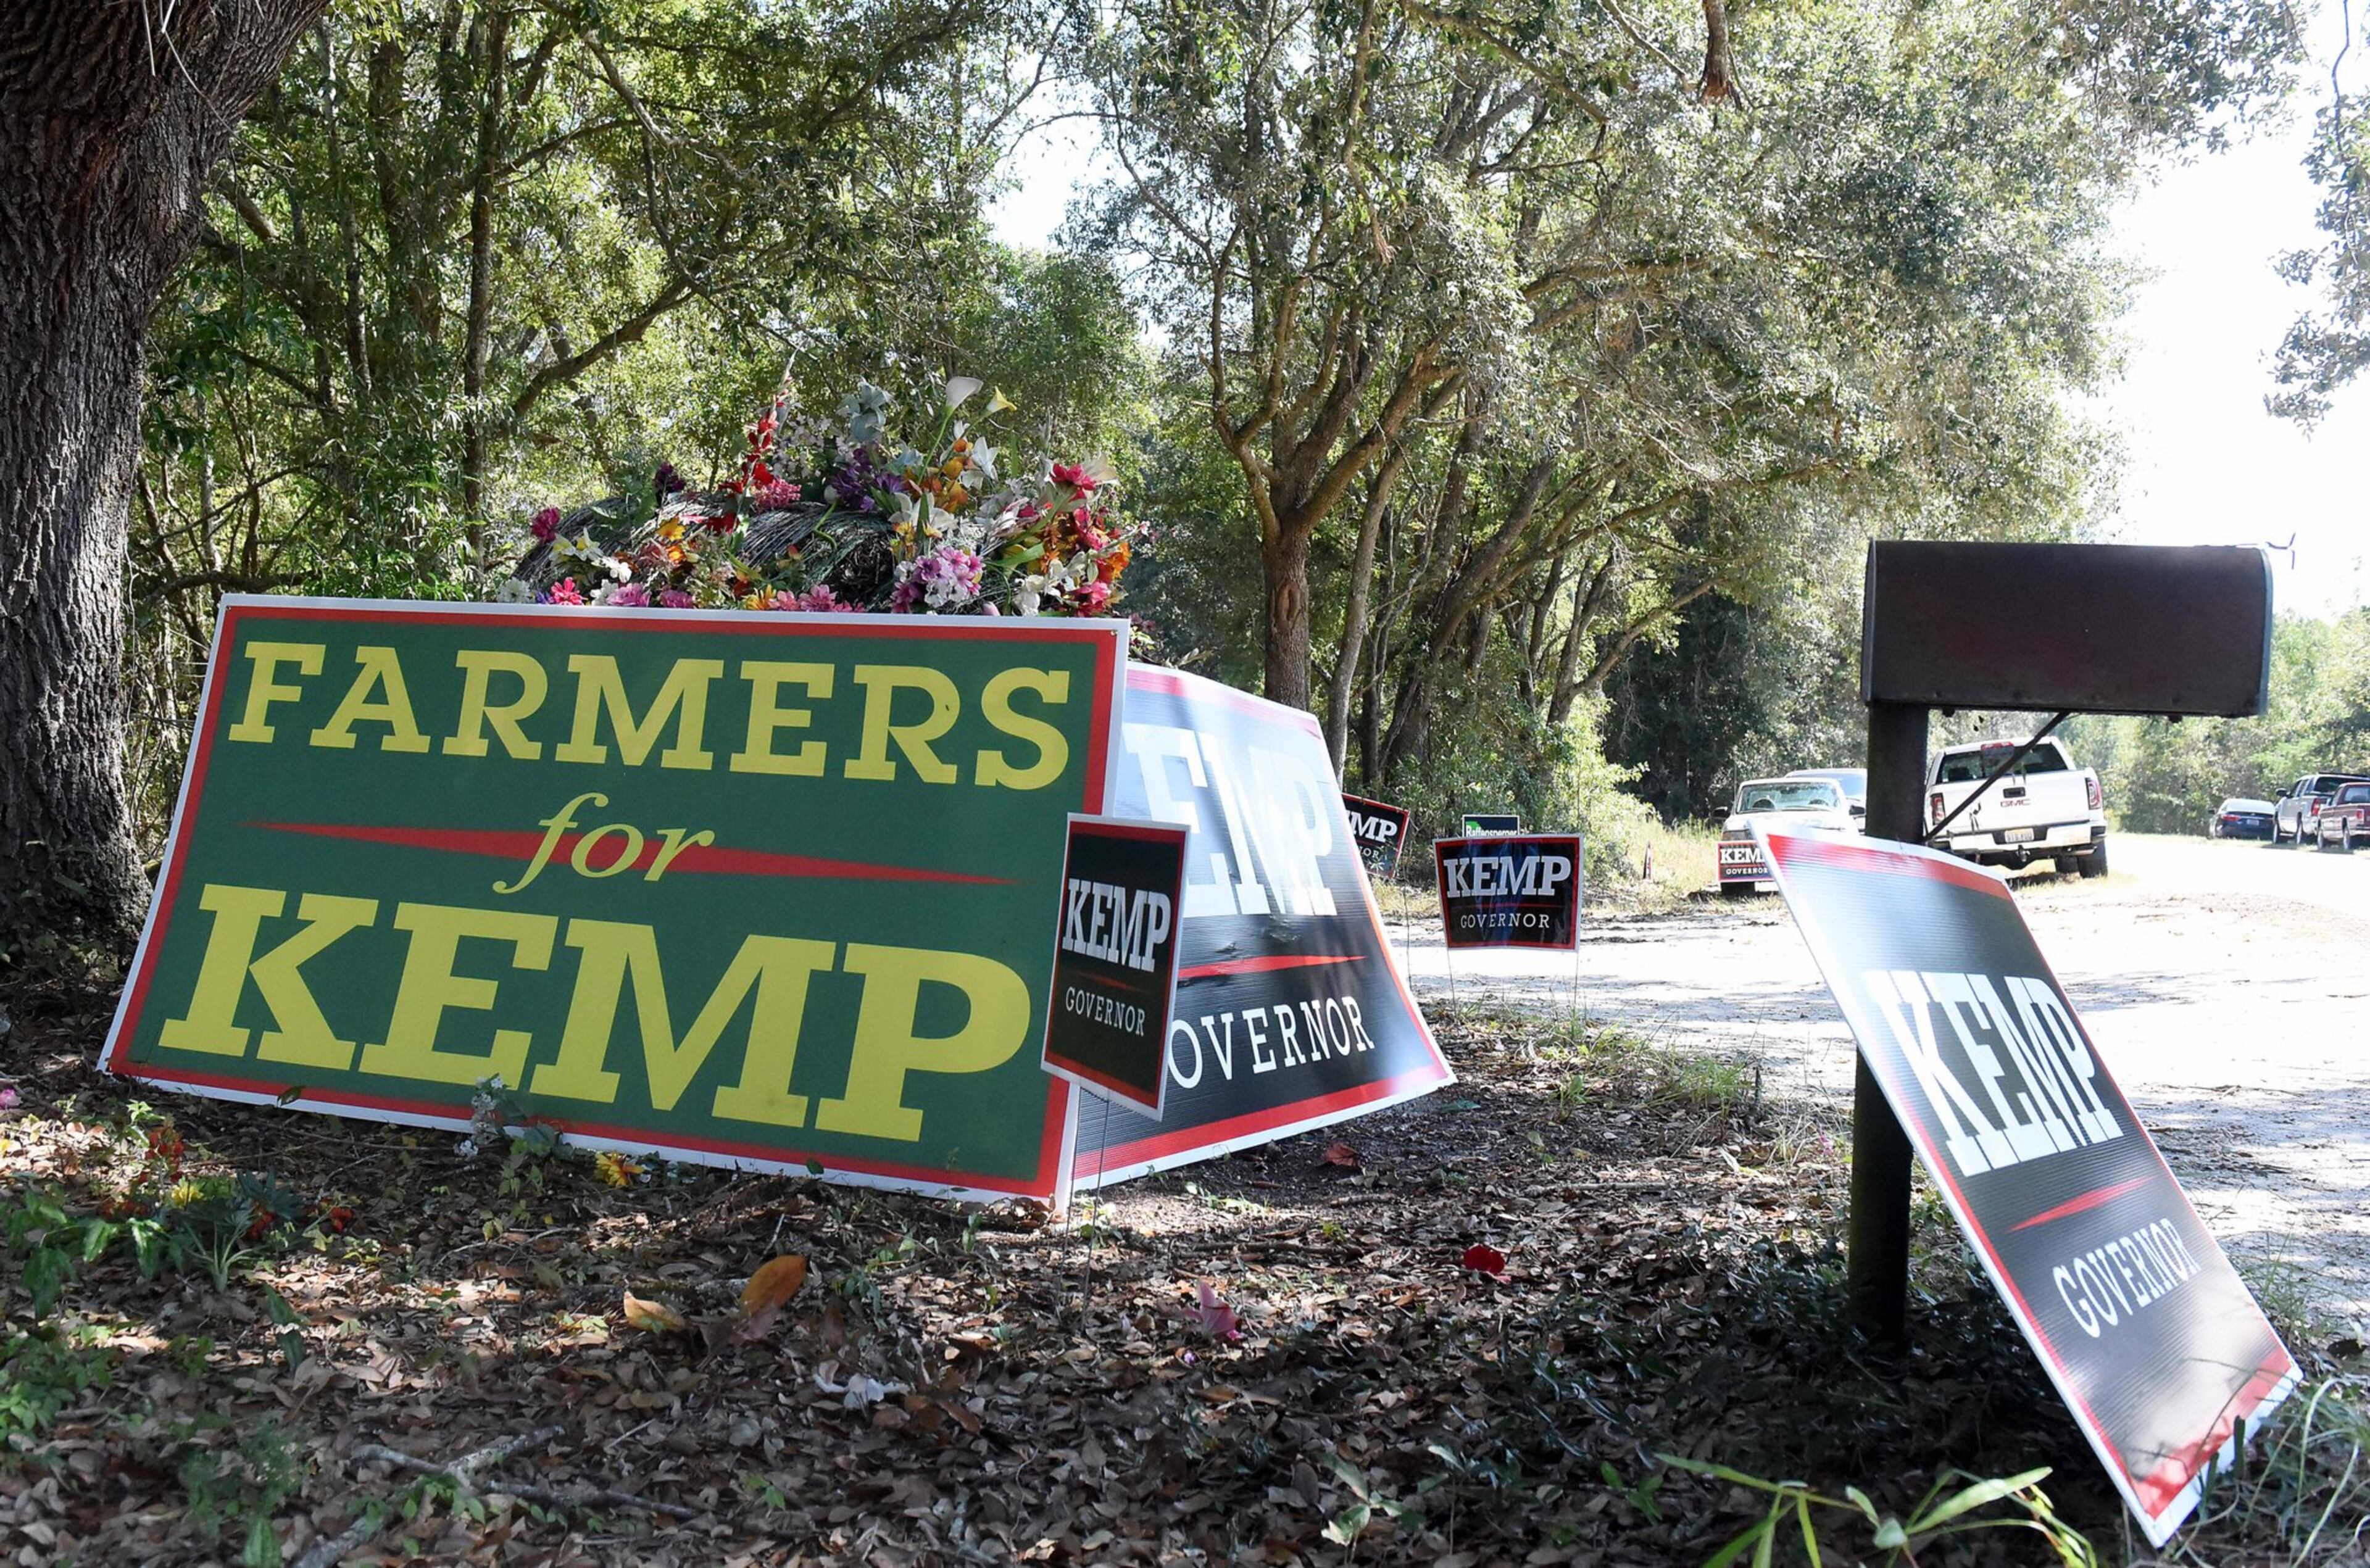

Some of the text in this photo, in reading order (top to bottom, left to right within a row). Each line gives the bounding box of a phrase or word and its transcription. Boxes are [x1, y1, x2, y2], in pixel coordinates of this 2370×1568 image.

[228, 640, 1071, 790] FARMERS
[493, 792, 714, 894] for
[1121, 722, 1338, 918] EMP
[1347, 810, 1398, 843] MP
[2000, 799, 2031, 807] GMC
[1443, 855, 1571, 898] KEMP
[1720, 847, 1765, 863] KEM
[1062, 877, 1171, 973] KEMP
[1460, 913, 1550, 929] GOVERNOR
[159, 883, 1031, 1142] KEMP
[1065, 986, 1146, 1037] GOVERNOR
[1168, 995, 1375, 1089] OVERNOR
[1863, 970, 2124, 1177] KEMP
[2052, 1217, 2202, 1338] GOVERNOR
